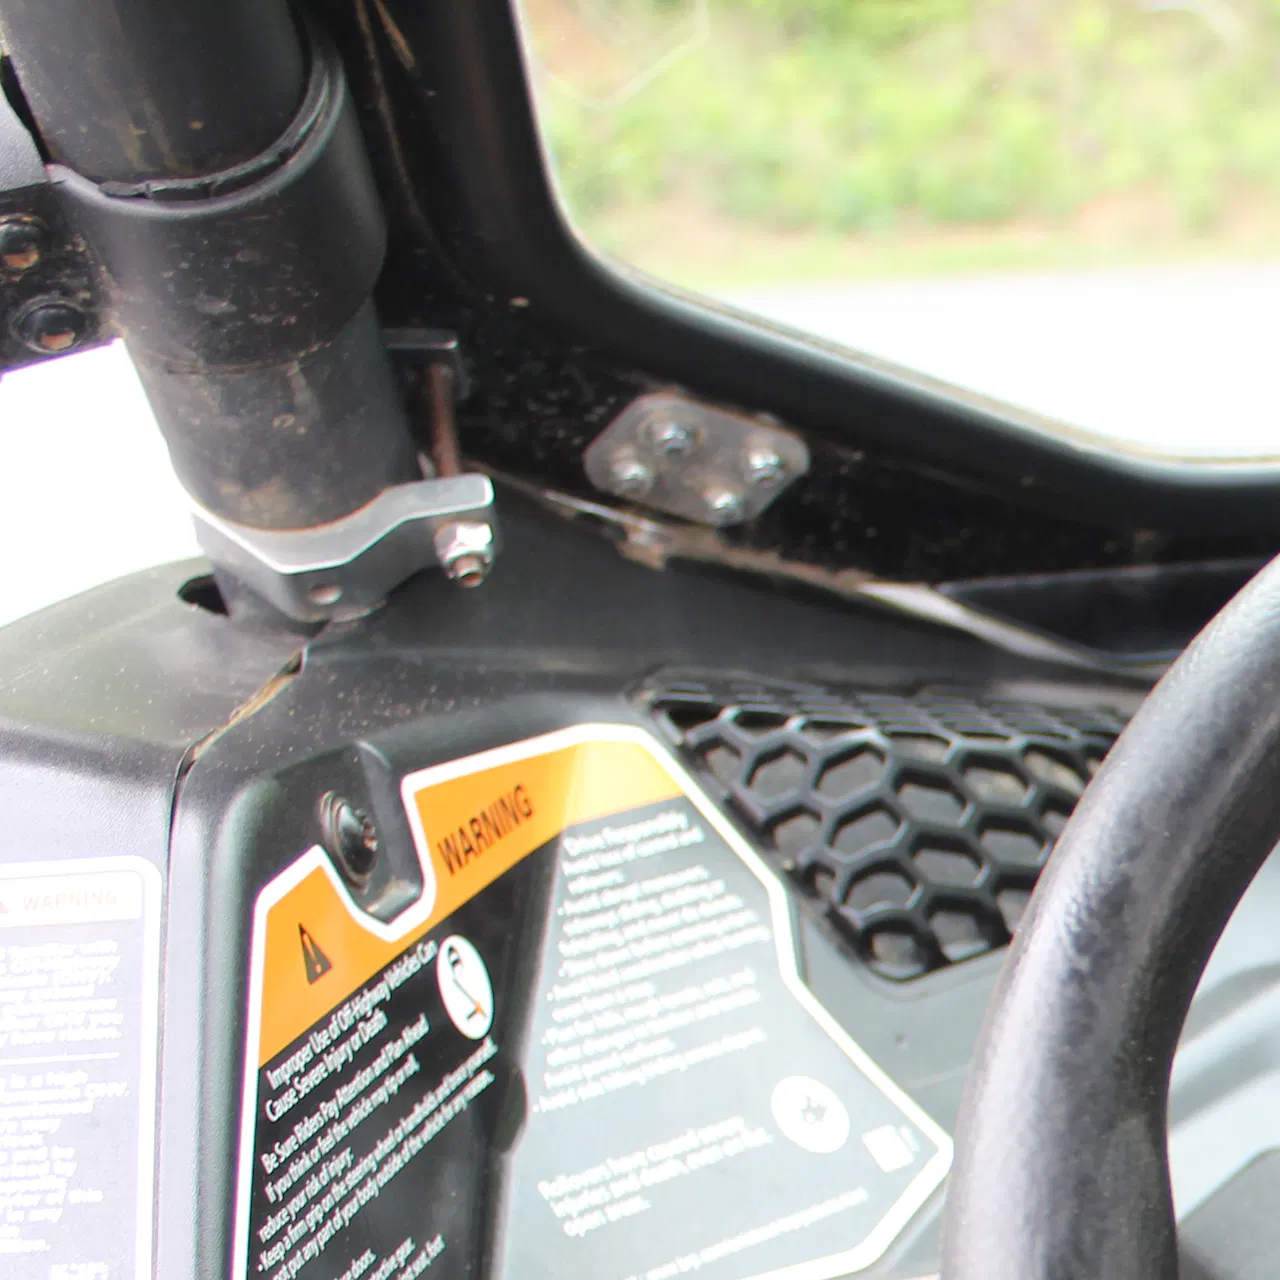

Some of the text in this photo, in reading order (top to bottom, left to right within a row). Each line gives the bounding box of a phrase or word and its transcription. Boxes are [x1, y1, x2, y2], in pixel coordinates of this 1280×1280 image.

[436, 784, 534, 877] WARNING
[265, 1008, 387, 1122] Cause Severe Injury or Death
[266, 1042, 314, 1090] Improper
[308, 1029, 332, 1054] Use
[328, 1015, 341, 1040] of
[336, 976, 391, 1031] Off-Highway
[416, 940, 441, 966] Can
[261, 1152, 279, 1174] Be
[274, 1134, 299, 1163] Sure
[293, 1111, 325, 1145] Riders
[319, 1098, 341, 1122] Pay
[335, 1066, 376, 1109] Attention
[371, 1048, 390, 1077] and
[401, 1014, 429, 1049] Ahead
[264, 1181, 277, 1203] If
[273, 1172, 293, 1202] you
[288, 1151, 313, 1182] think
[309, 1145, 321, 1163] or
[317, 1128, 336, 1155] feel
[331, 1120, 349, 1142] the
[345, 1097, 374, 1130] vehicle
[370, 1083, 389, 1108] may
[384, 1075, 399, 1094] tip
[395, 1067, 406, 1085] or
[258, 1207, 290, 1243] reduce
[286, 1189, 307, 1221] your
[304, 1174, 323, 1200] risk
[318, 1162, 330, 1186] of
[259, 1241, 286, 1271] Keep
[282, 1235, 292, 1251] a
[287, 1219, 308, 1244] firm
[305, 1203, 324, 1233] grip
[321, 1193, 336, 1213] on
[330, 1180, 348, 1202] the
[344, 1152, 378, 1191] steering
[372, 1129, 398, 1162] wheel
[393, 1124, 407, 1144] or
[286, 1250, 306, 1280] put
[315, 1219, 336, 1251] part
[340, 1195, 360, 1227] your
[355, 1177, 379, 1206] body
[372, 1153, 404, 1188] outside
[407, 1134, 424, 1155] the
